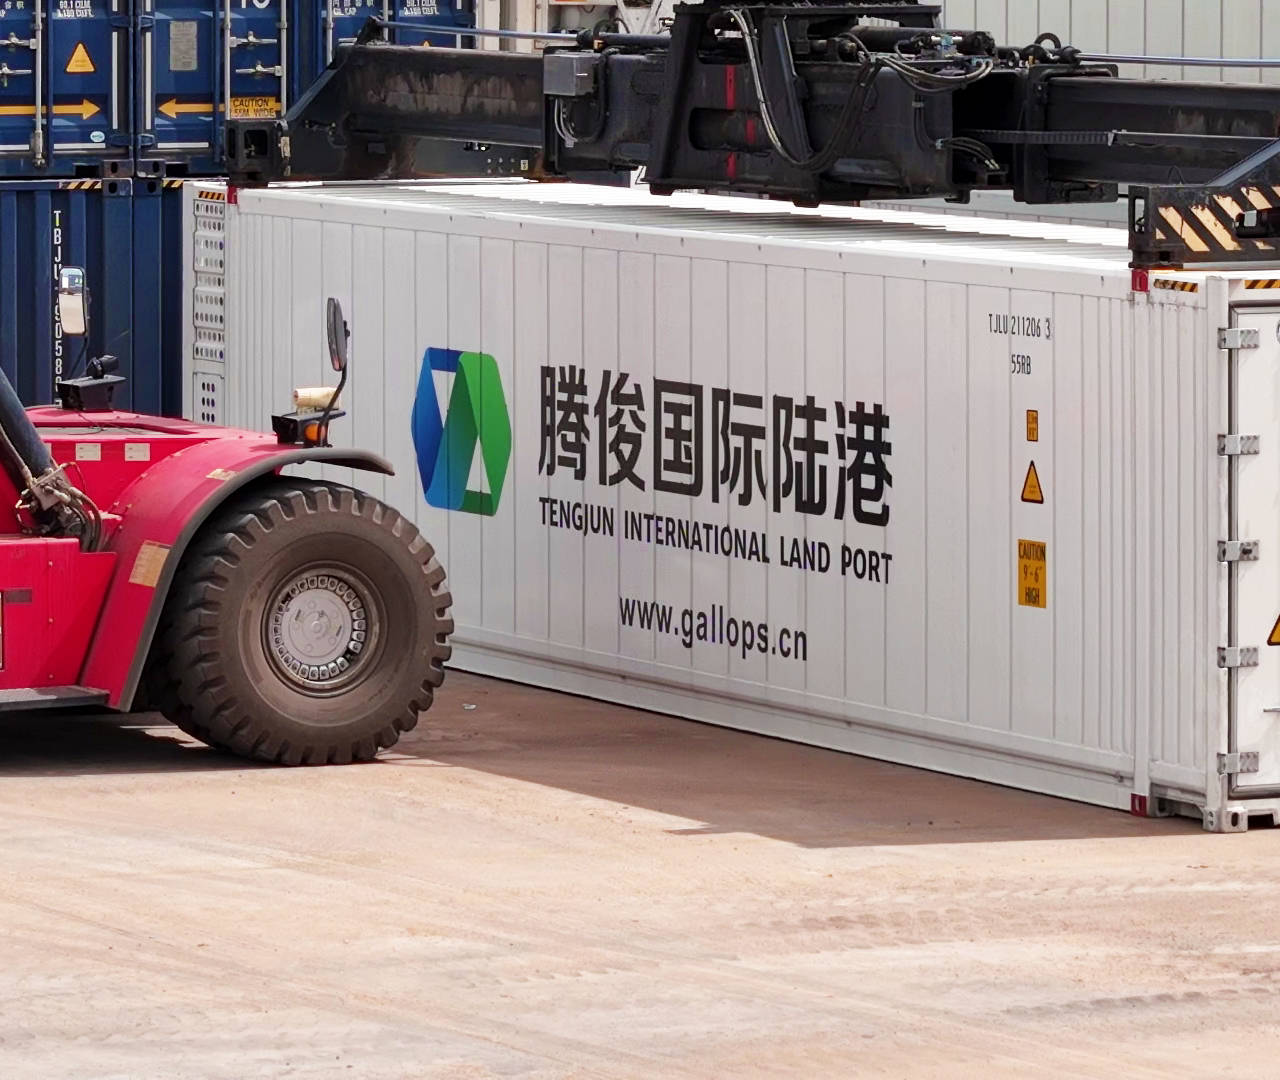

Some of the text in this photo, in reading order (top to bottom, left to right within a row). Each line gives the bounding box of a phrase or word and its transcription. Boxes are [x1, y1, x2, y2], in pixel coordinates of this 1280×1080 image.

[232, 97, 270, 108] CAUTION
[988, 313, 1051, 340] TJLU 211206 3
[1011, 353, 1032, 375] 55RB
[538, 364, 894, 527] 腾俊国际陆港
[538, 496, 894, 585] TENGJUN INTERNATIONAL LAND PORT
[1019, 542, 1046, 562] CAUTION
[1025, 588, 1040, 606] HIGH
[619, 596, 808, 661] www.gallops.cn
